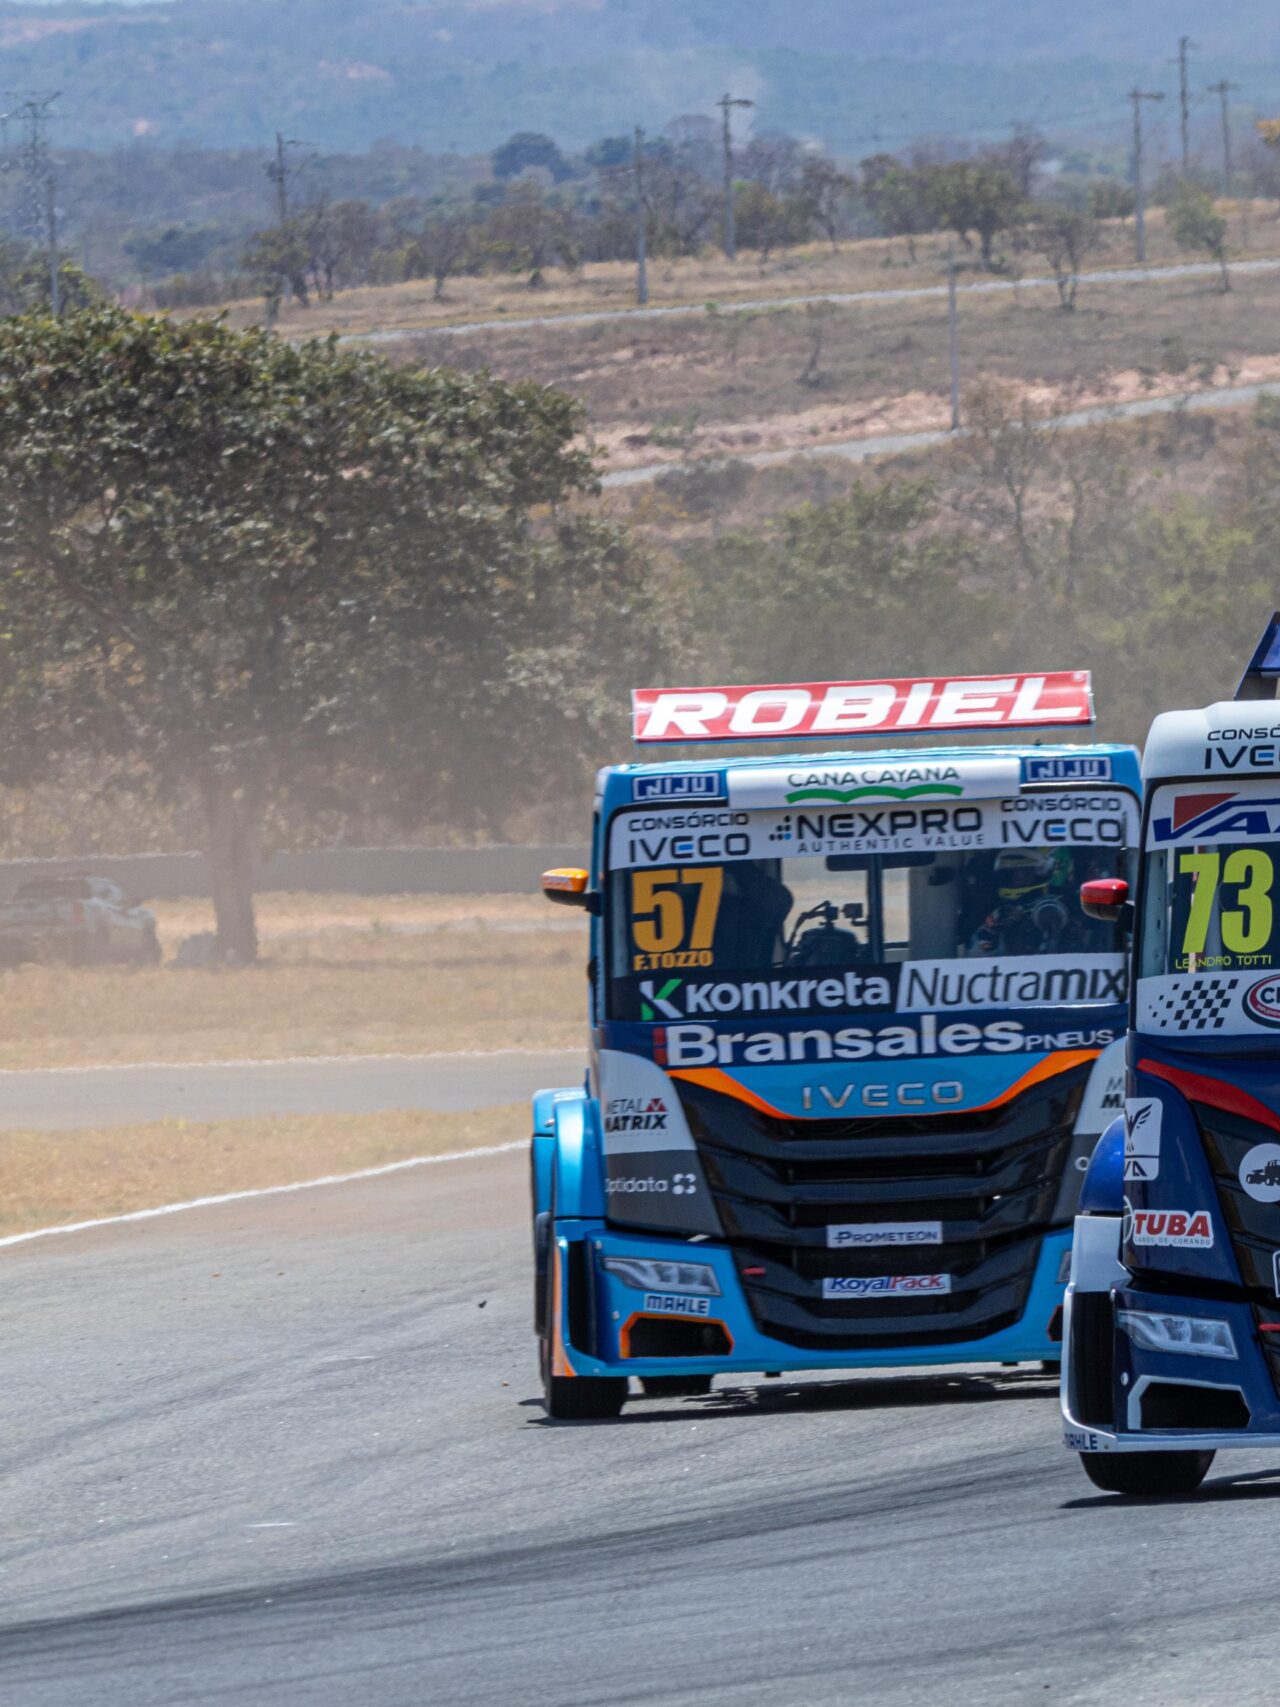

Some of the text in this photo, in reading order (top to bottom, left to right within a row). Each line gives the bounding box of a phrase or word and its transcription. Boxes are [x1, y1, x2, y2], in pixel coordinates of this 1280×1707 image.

[641, 677, 1085, 737] ROBIEL
[1001, 795, 1122, 812] CONSÓRCIO
[628, 812, 750, 832] CONSÓRCIO
[796, 807, 983, 839] NEXPRO
[1002, 818, 1122, 844] IVECO
[628, 833, 750, 863] IVECO
[798, 833, 985, 853] AUTHENTIC VALUE
[632, 866, 724, 953] 57
[1179, 848, 1274, 954] 73
[633, 950, 714, 971] F.TOZZO
[1174, 953, 1272, 970] LEANDRO TOTTI
[907, 965, 1127, 1008] Nuctramix
[667, 1015, 1115, 1066] Bransales PNEUS
[802, 1080, 964, 1110] IVECO
[833, 1230, 938, 1244] PROMETEON
[1134, 1213, 1210, 1238] TUBA
[830, 1275, 944, 1296] RoyalPack
[647, 1295, 709, 1314] MAHLE
